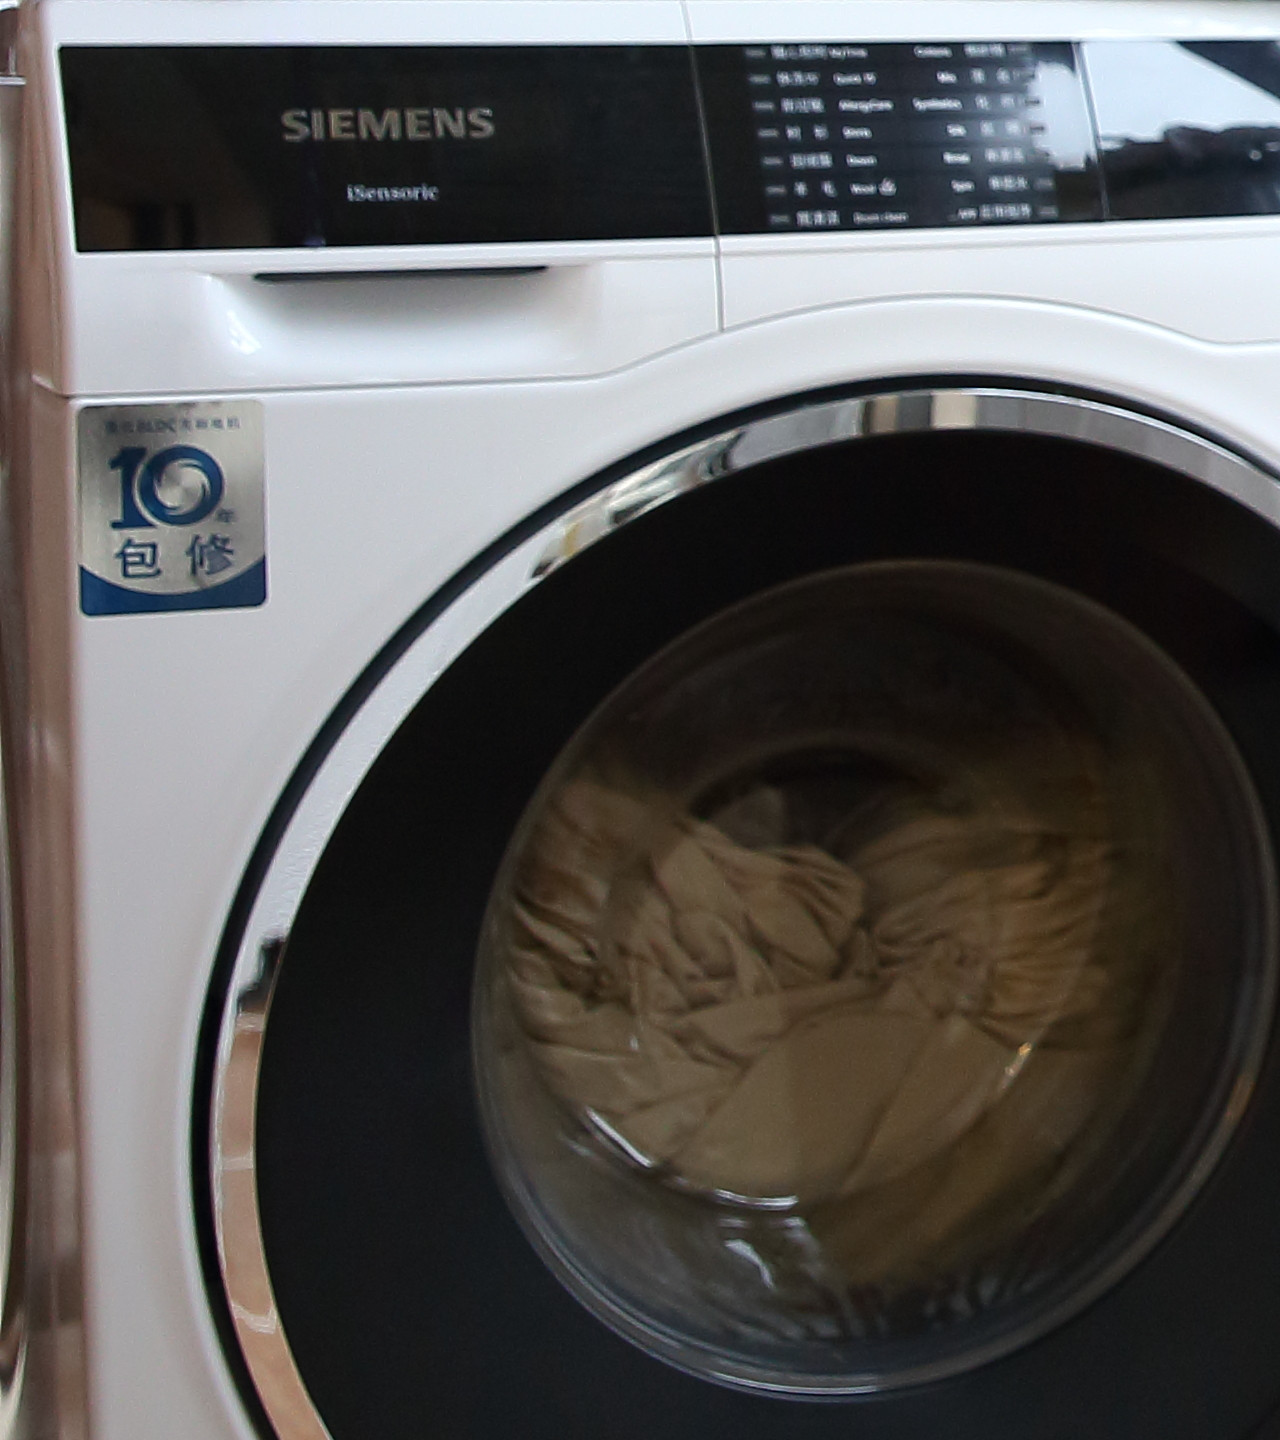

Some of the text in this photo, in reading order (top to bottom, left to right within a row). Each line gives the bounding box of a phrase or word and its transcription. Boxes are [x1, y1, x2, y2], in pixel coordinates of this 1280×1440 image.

[281, 108, 495, 142] SIEMENS
[347, 184, 440, 202] iSensoric
[109, 443, 224, 528] 10
